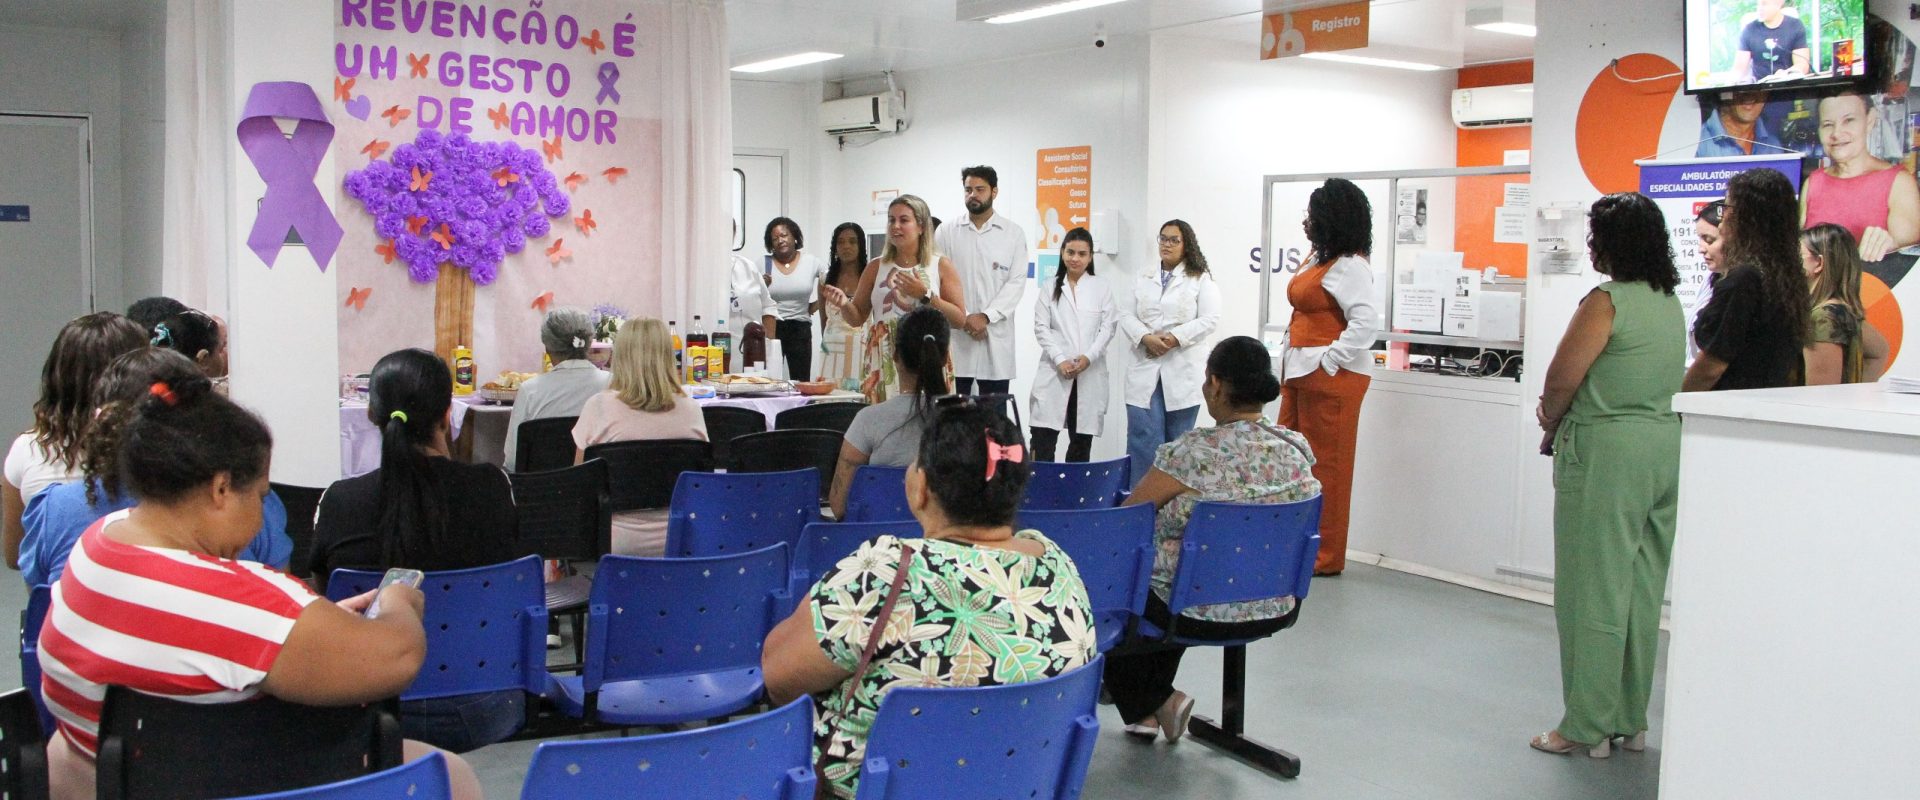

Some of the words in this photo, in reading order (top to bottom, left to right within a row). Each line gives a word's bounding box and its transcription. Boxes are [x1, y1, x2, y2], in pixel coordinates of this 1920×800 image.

[1311, 16, 1361, 32] Registro
[613, 13, 637, 57] É
[335, 42, 397, 80] UM
[438, 51, 570, 98] GESTO
[416, 95, 474, 133] DE
[510, 101, 618, 144] AMOR
[1044, 154, 1071, 162] Assistente
[1072, 152, 1088, 160] Social
[1038, 177, 1071, 187] Classificação
[1072, 177, 1087, 185] Risco
[1649, 182, 1714, 193] ESPECIALIDADES
[1069, 201, 1087, 209] Sutura
[1673, 227, 1691, 237] 191
[1682, 249, 1695, 258] 14
[1694, 262, 1707, 271] 16
[1690, 274, 1704, 284] 10
